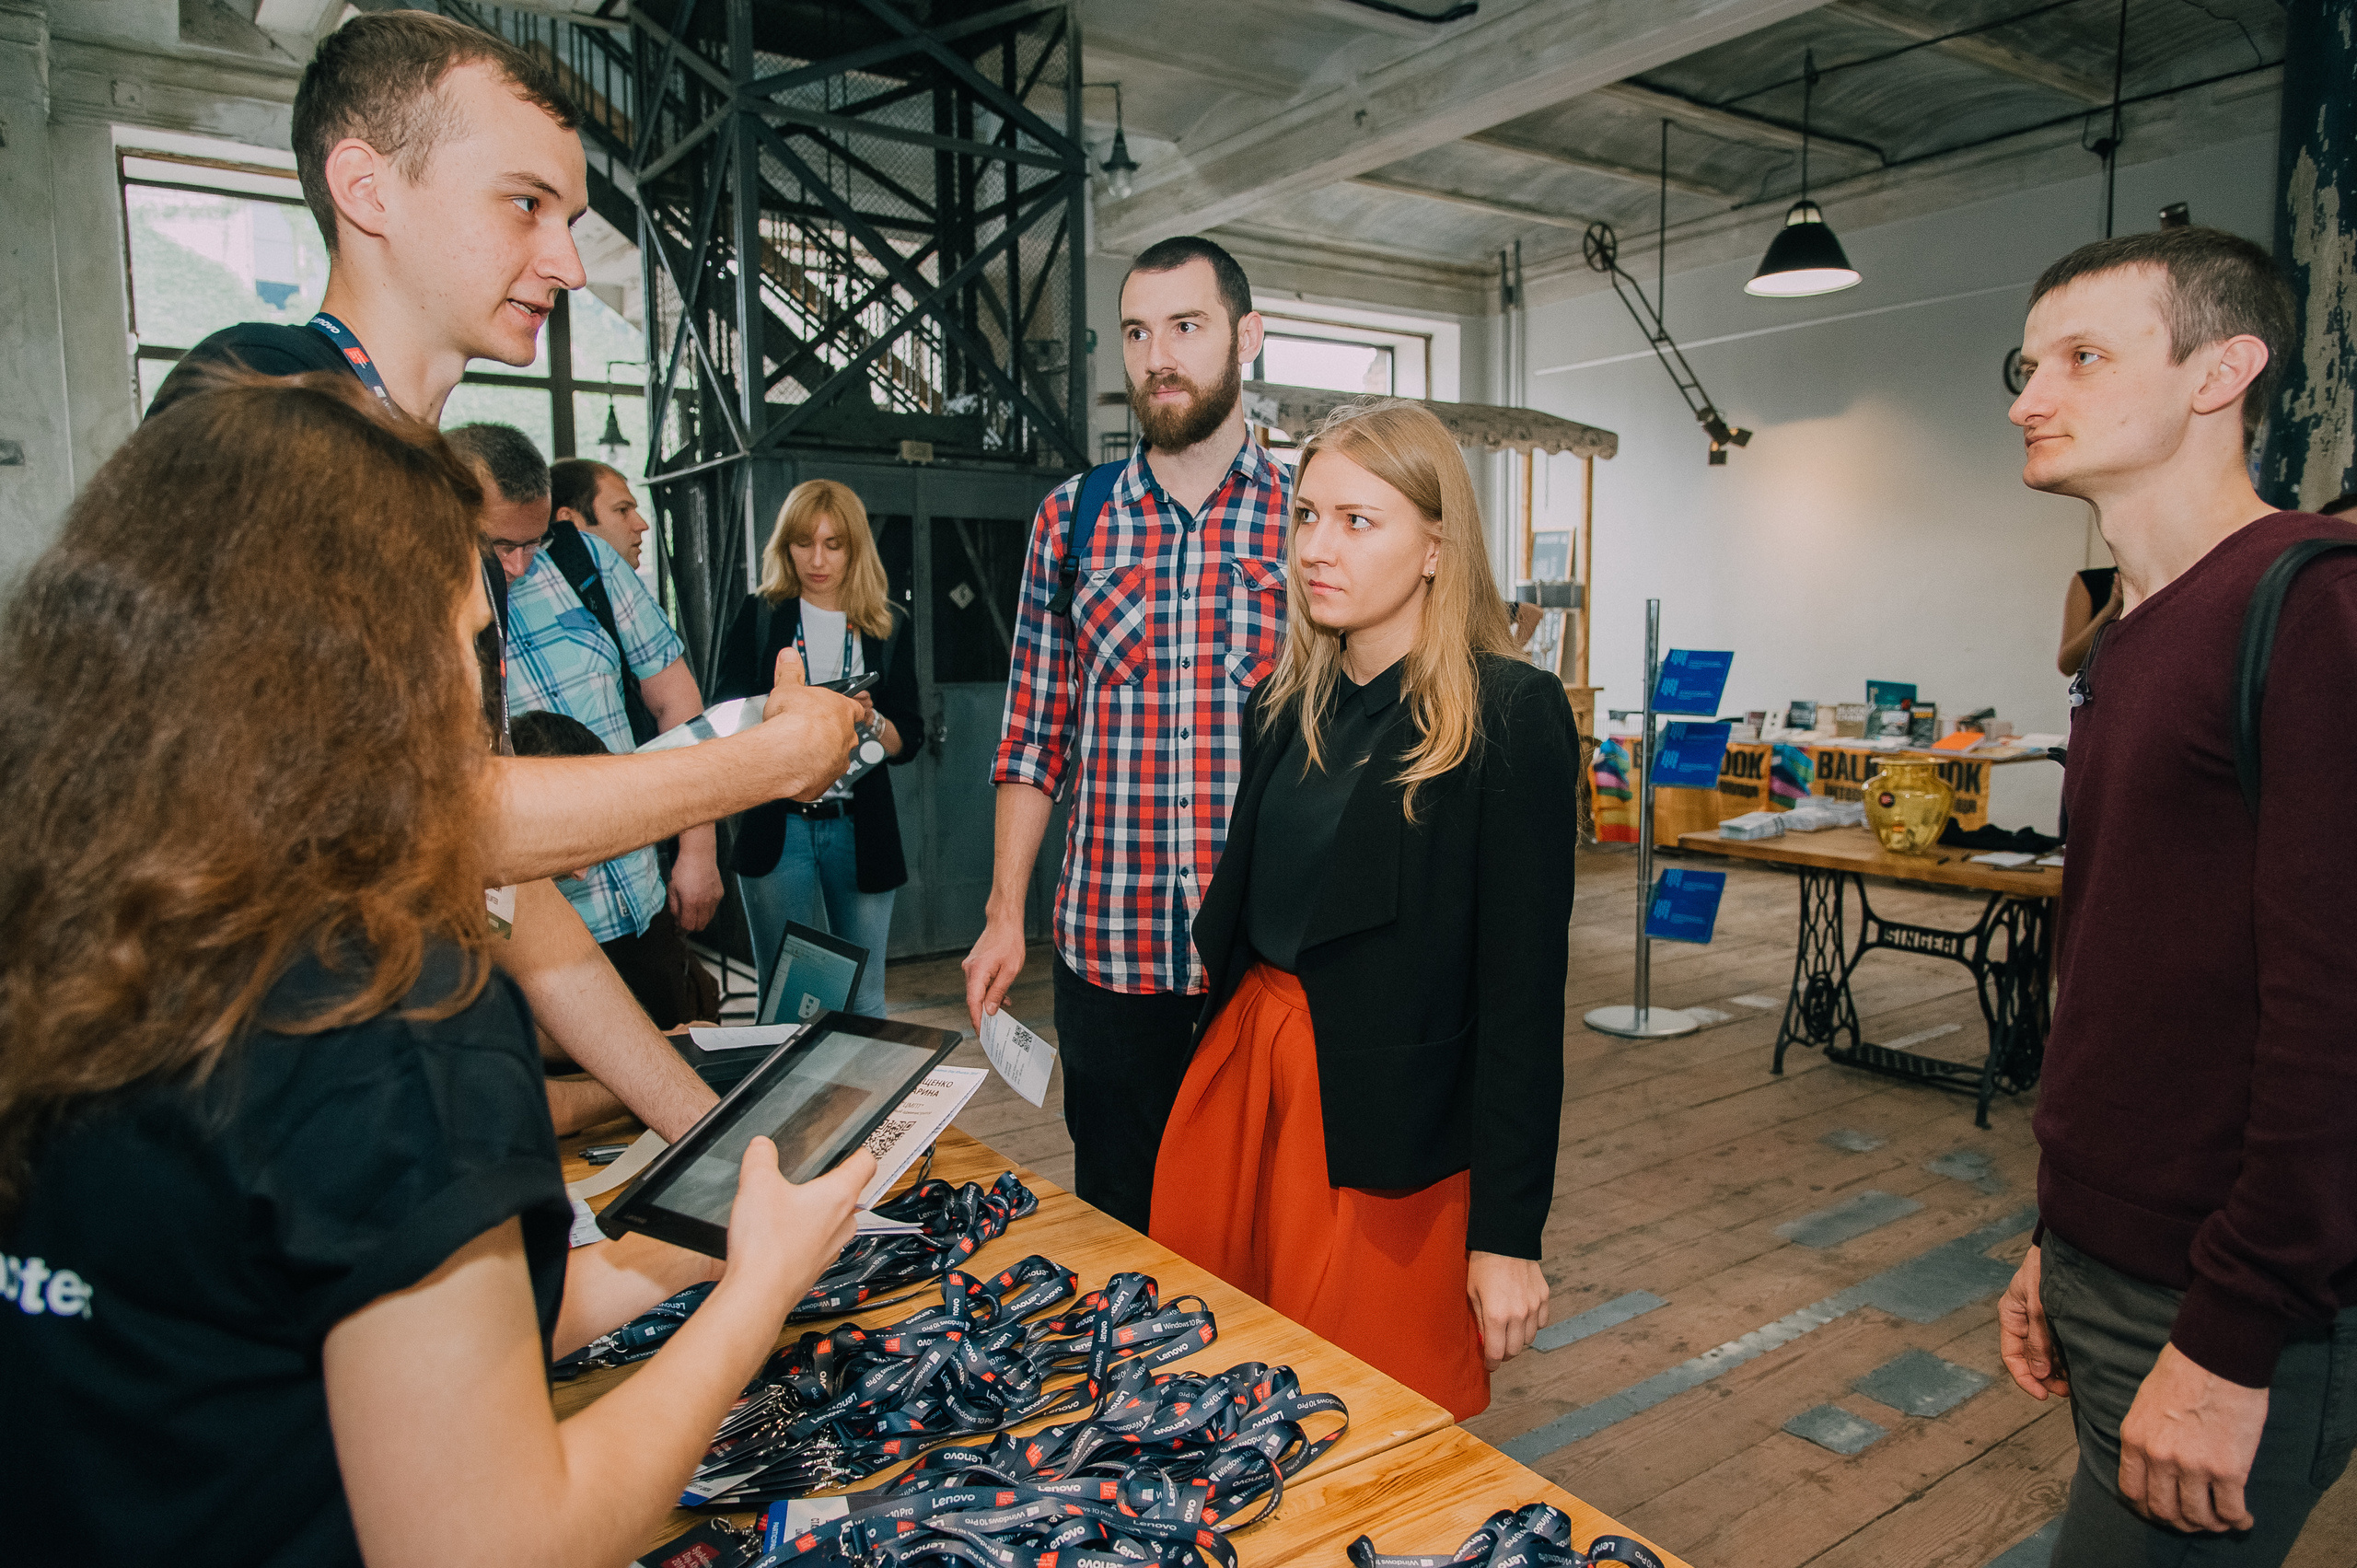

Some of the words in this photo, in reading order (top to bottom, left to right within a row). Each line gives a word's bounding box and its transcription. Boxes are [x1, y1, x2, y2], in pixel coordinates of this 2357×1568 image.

[1010, 1293, 1041, 1312] Lenovo
[905, 1308, 936, 1326] Lenovo
[922, 1323, 933, 1332] Pro
[1163, 1320, 1190, 1330] Windows
[1189, 1318, 1196, 1328] 10
[1097, 1320, 1108, 1342] Lenovo
[1155, 1342, 1190, 1362] Lenovo
[988, 1357, 997, 1366] 10
[995, 1353, 1007, 1365] Pro
[865, 1376, 876, 1388] Pro
[874, 1372, 882, 1381] 10
[1110, 1372, 1121, 1381] Pro
[1017, 1394, 1051, 1414] Lenovo
[1024, 1395, 1033, 1403] 10
[1202, 1399, 1213, 1410] Pro
[1212, 1394, 1221, 1406] 10
[1297, 1400, 1308, 1410] Pro
[1308, 1399, 1317, 1408] 10
[952, 1401, 978, 1423] Windows
[977, 1416, 985, 1424] 10
[1043, 1400, 1080, 1416] Lenovo
[810, 1409, 847, 1424] Lenovo
[1153, 1418, 1192, 1436] Lenovo
[1072, 1427, 1098, 1460] Lenovo
[944, 1452, 983, 1466] Lenovo
[1216, 1454, 1245, 1481] Windows
[1242, 1450, 1252, 1460] 10
[1232, 1472, 1271, 1488] Lenovo
[1038, 1484, 1082, 1493] Lenovo
[932, 1493, 976, 1509] Lenovo
[900, 1507, 914, 1517] Pro
[989, 1511, 1026, 1525] Windows
[1091, 1507, 1099, 1516] 10
[1099, 1508, 1114, 1518] Pro
[964, 1517, 979, 1527] Pro
[1132, 1520, 1178, 1532] Lenovo
[968, 1530, 999, 1557] Windows
[1050, 1526, 1086, 1550] enovo
[1504, 1537, 1516, 1549] Pro
[900, 1541, 946, 1561] Lenovo
[965, 1548, 977, 1559] Pro
[1453, 1533, 1492, 1562] Lenovo
[976, 1553, 986, 1565] 10
[1634, 1551, 1647, 1564] Pro
